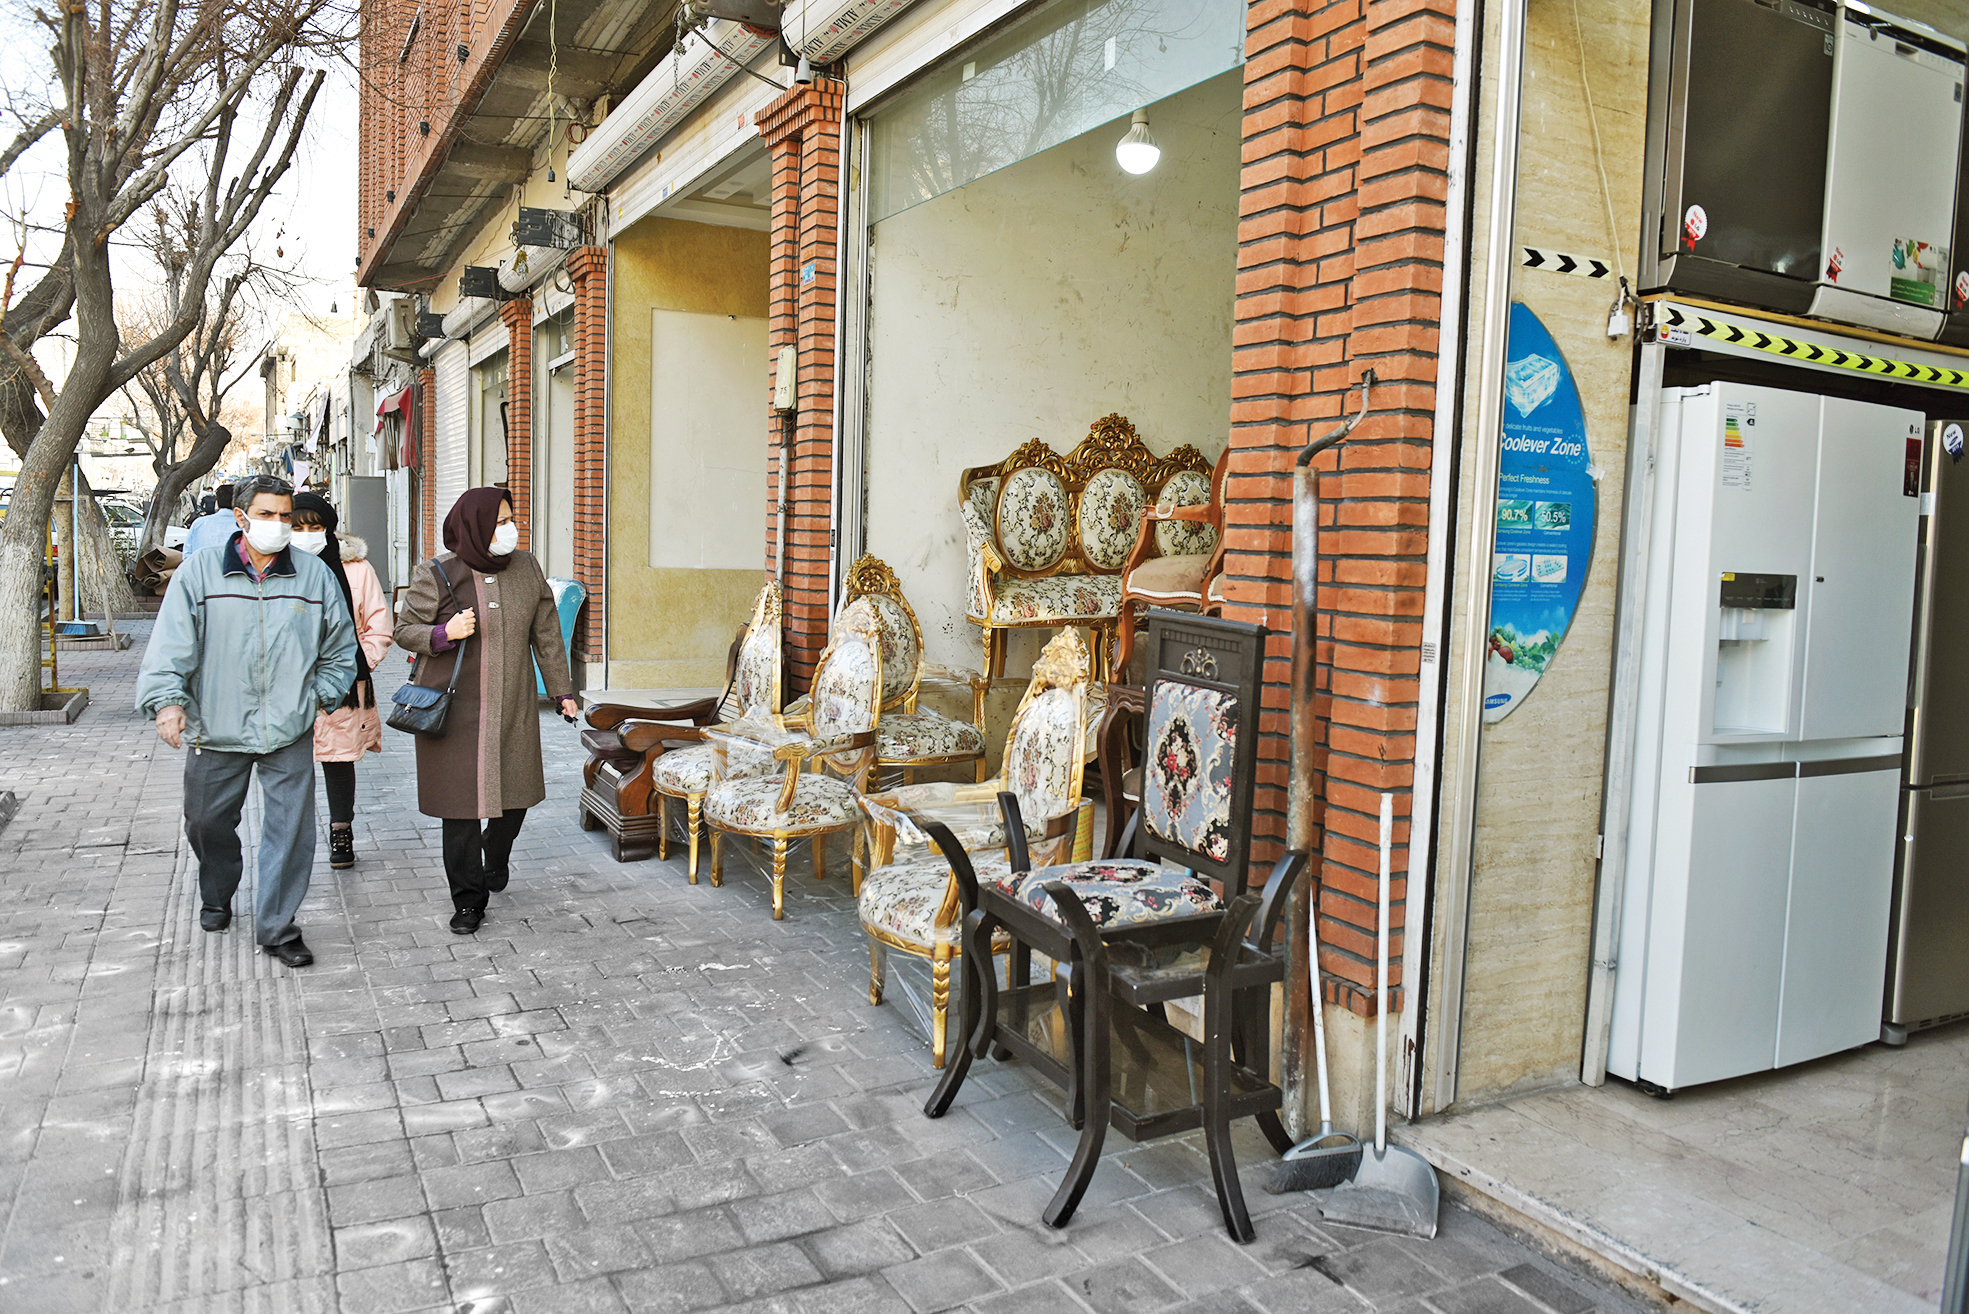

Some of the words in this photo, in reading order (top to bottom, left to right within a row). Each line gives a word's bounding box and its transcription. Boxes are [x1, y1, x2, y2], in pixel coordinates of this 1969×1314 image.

[833, 8, 859, 30] ALMA
[1550, 437, 1581, 456] Zone
[1500, 473, 1519, 482] Perfect
[1520, 474, 1550, 484] Freshness
[1502, 509, 1528, 521] 90.7%
[1541, 511, 1566, 523] 50.5%
